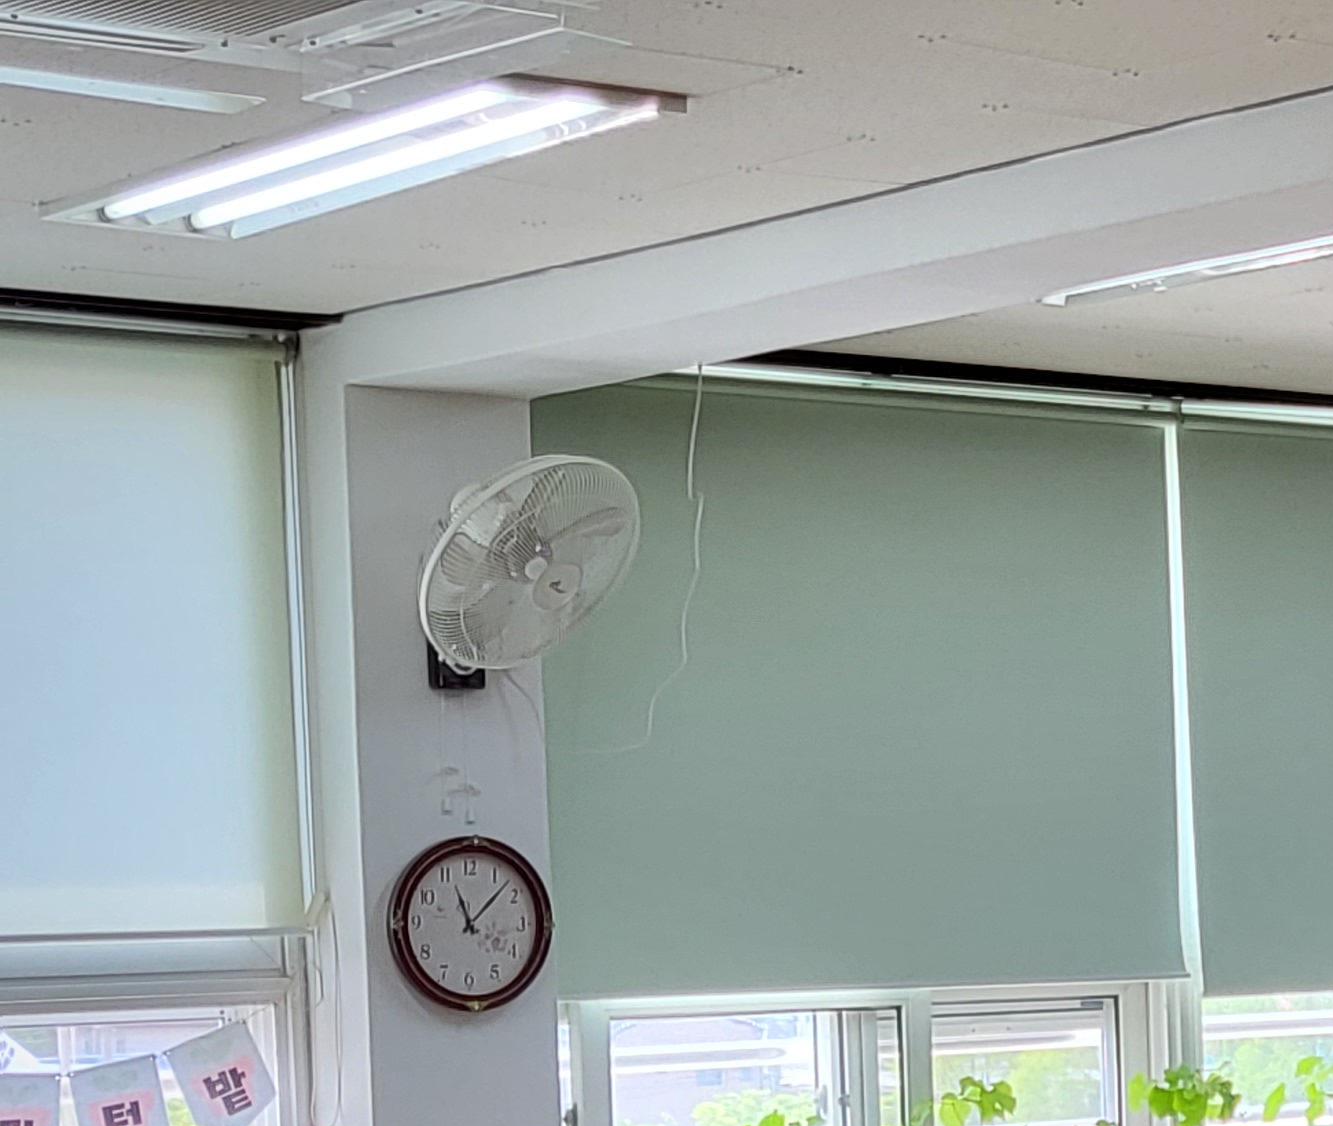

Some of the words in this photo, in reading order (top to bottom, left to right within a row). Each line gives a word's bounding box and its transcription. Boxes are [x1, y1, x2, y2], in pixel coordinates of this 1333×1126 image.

[439, 866, 451, 884] 11
[463, 859, 478, 877] 12
[420, 889, 435, 906] 10
[510, 888, 519, 904] 2
[411, 914, 422, 930] 9
[516, 915, 526, 933] 3
[420, 943, 431, 960] 8
[507, 943, 517, 960] 4
[439, 964, 449, 981] 7
[464, 972, 474, 989] 6
[489, 964, 500, 980] 5
